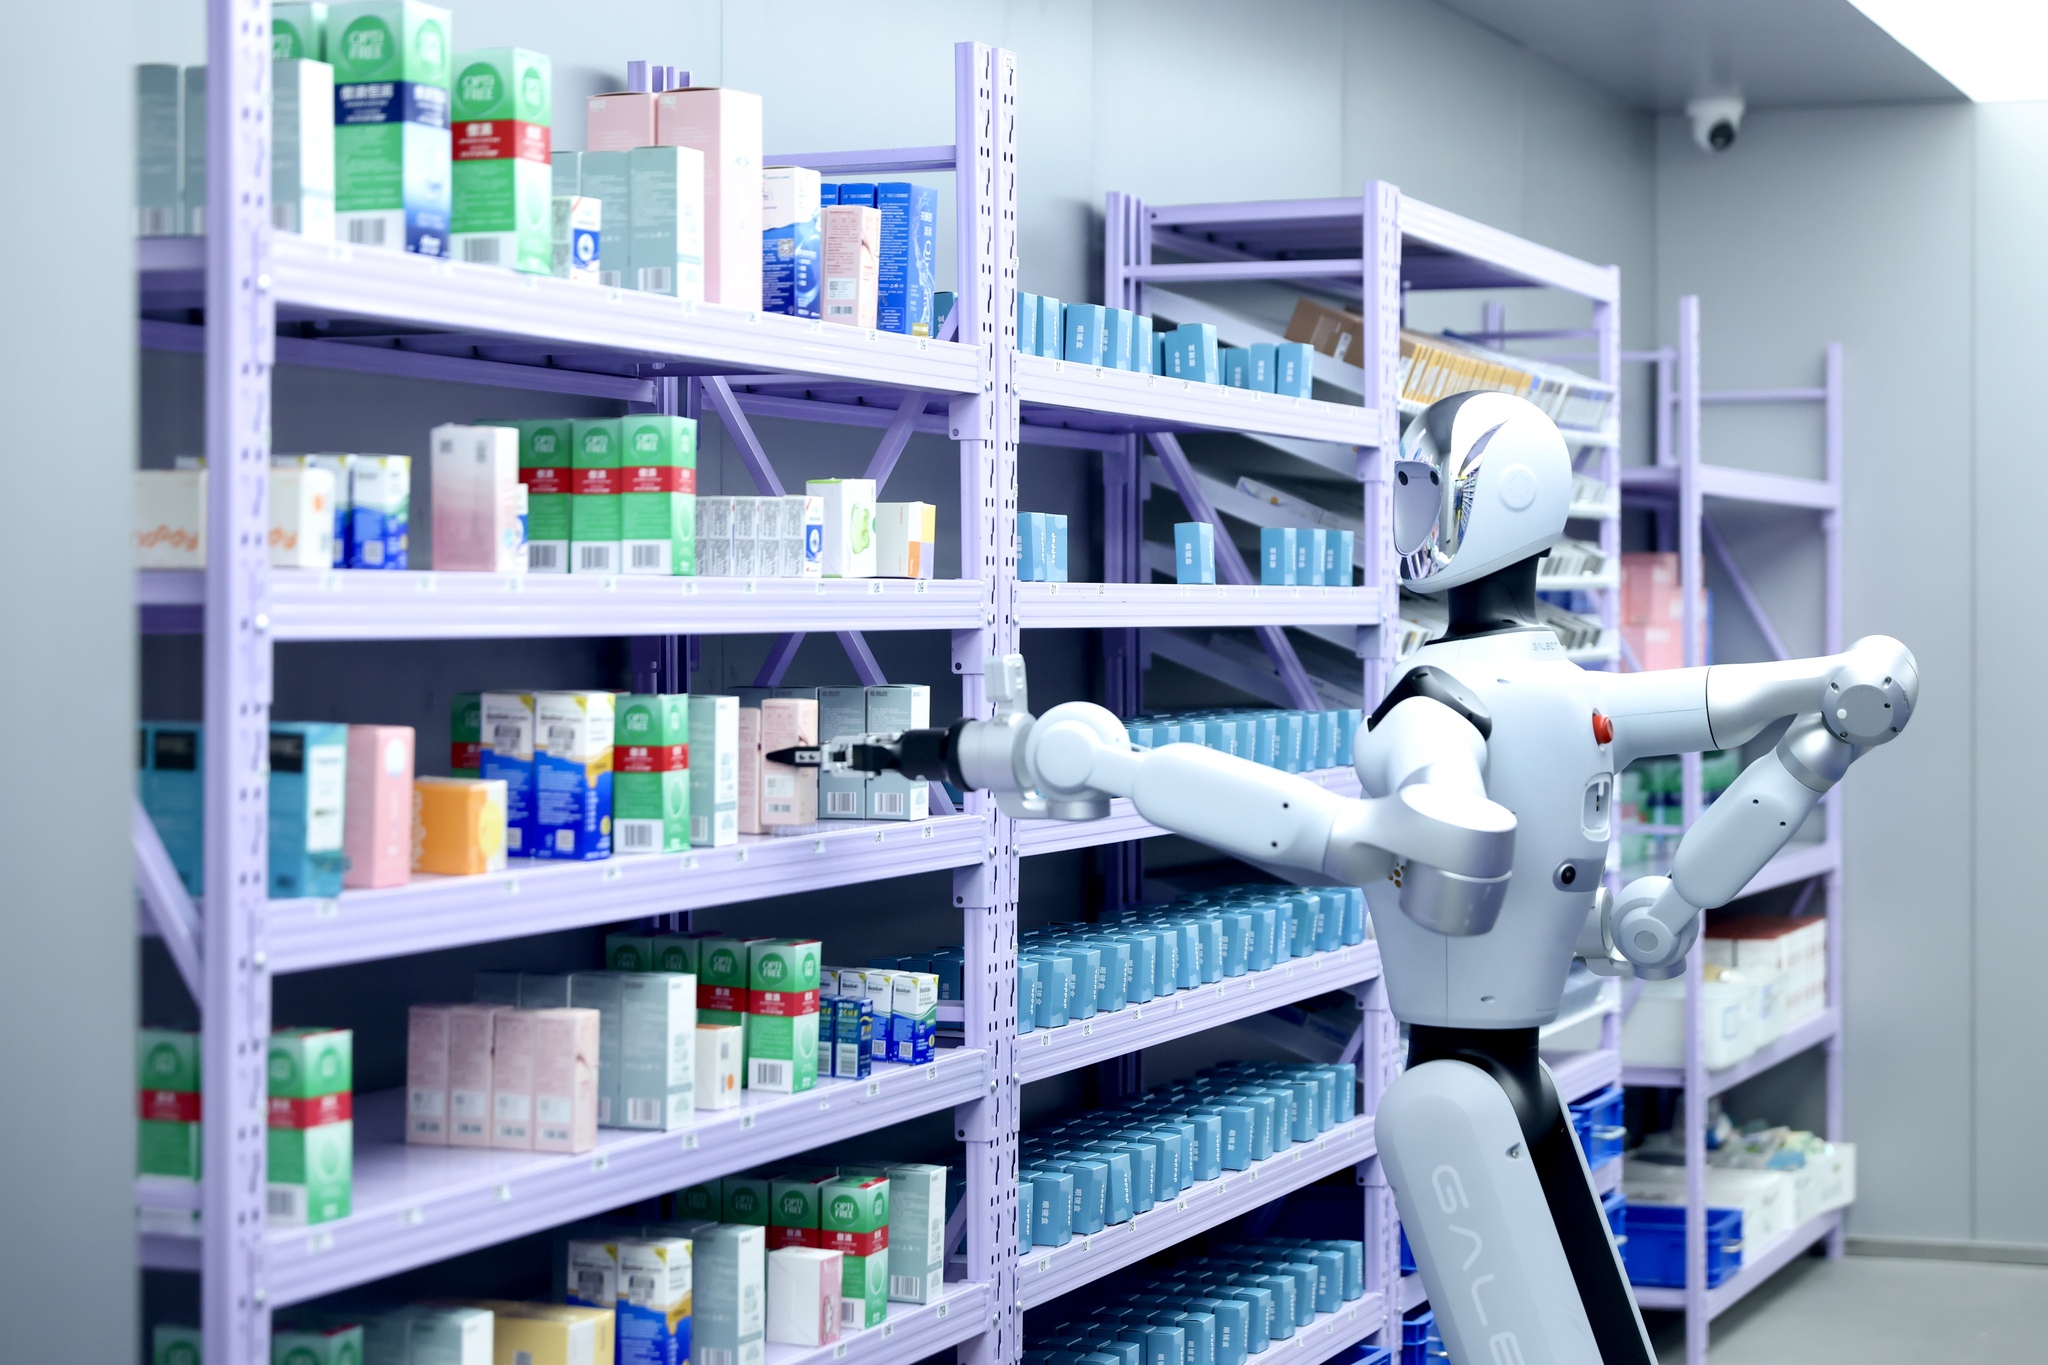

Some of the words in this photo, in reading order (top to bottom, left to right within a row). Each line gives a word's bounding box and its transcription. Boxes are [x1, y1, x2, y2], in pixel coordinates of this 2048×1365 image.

[1533, 642, 1557, 651] GALBOT
[1074, 1189, 1082, 1212] 眼镜盒
[836, 1210, 853, 1219] FREE
